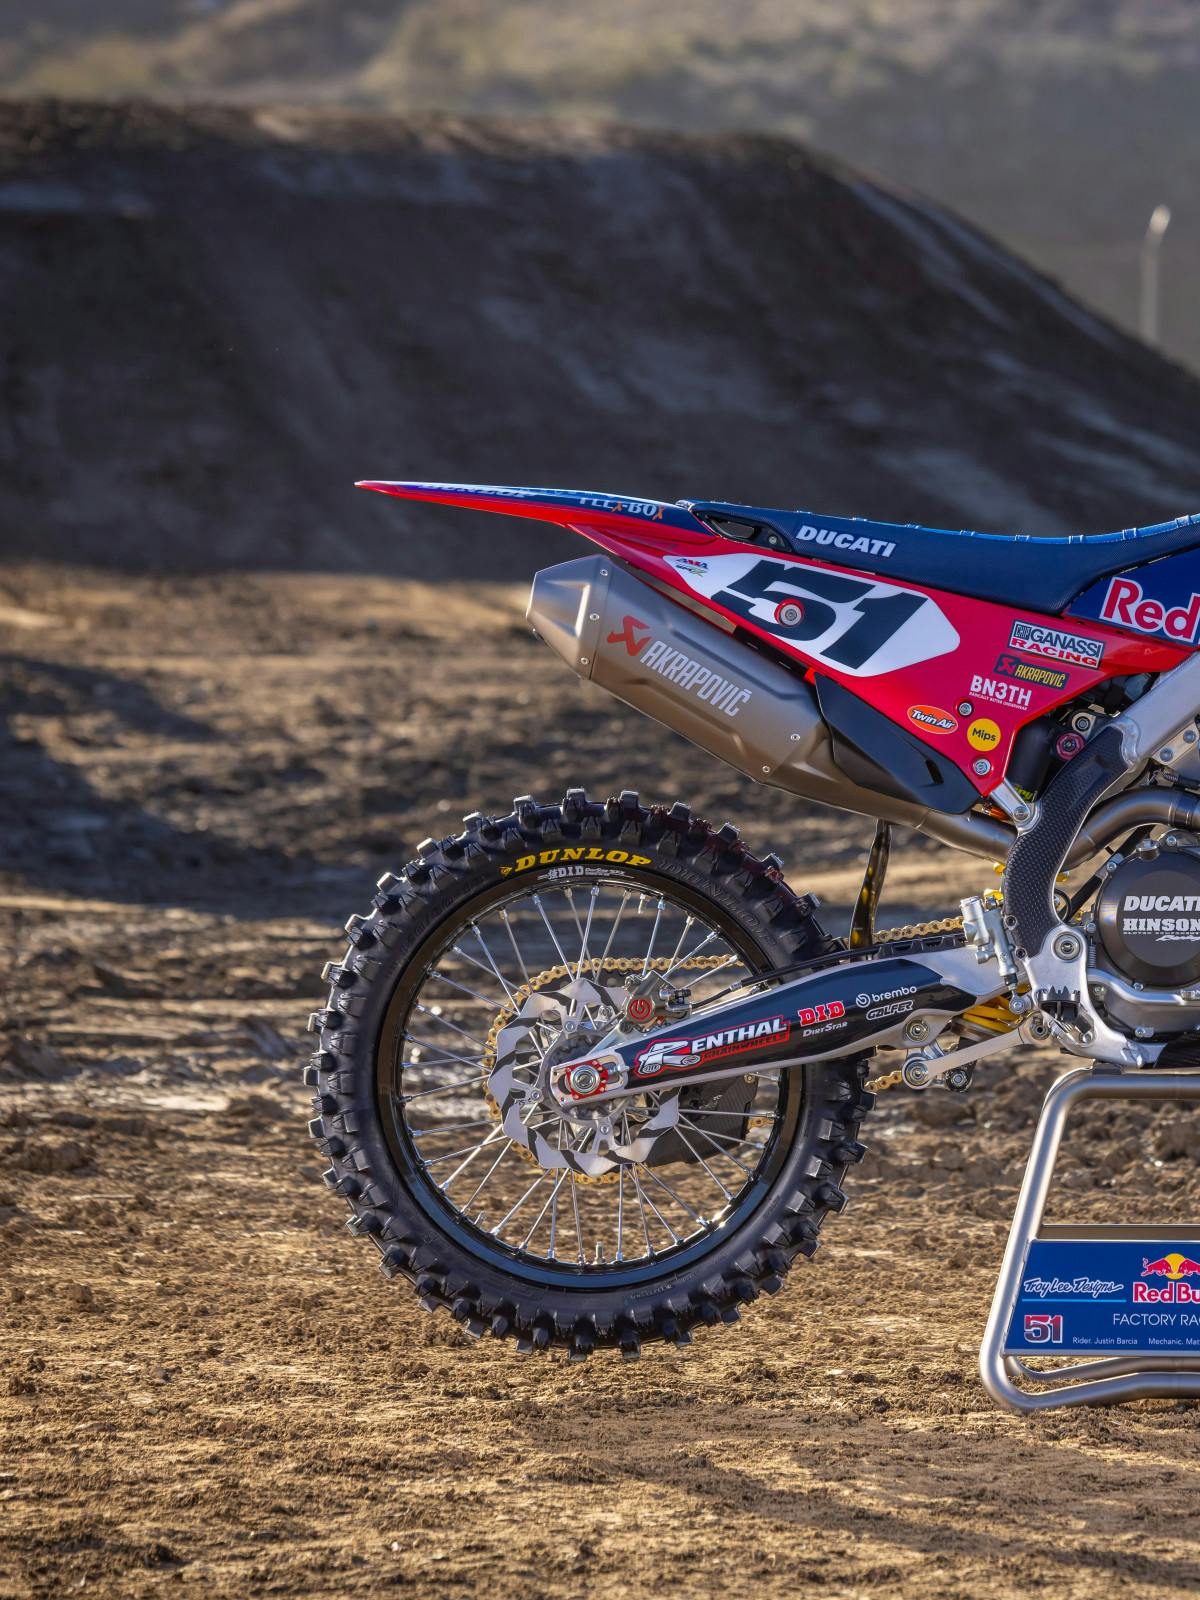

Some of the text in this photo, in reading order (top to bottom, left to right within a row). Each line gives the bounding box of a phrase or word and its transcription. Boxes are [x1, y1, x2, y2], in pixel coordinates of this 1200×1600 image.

[795, 525, 896, 558] DUCATI
[710, 560, 928, 669] 51
[1011, 638, 1097, 667] RACING
[1030, 628, 1103, 658] GANASSI
[640, 640, 752, 717] AKRAPOVIČ
[970, 675, 1032, 706] BN3TH
[911, 708, 955, 730] Twin Air
[972, 728, 996, 742] Mips
[515, 847, 653, 872] DUNLOP
[872, 985, 917, 1003] brembo
[798, 1001, 846, 1026] DID
[866, 999, 914, 1021] GALFER
[1023, 1277, 1124, 1299] Troy Lee Designs
[1133, 1281, 1175, 1304] Red
[1024, 1314, 1063, 1343] 51
[1113, 1313, 1177, 1326] FACTORY
[1094, 1337, 1115, 1345] Justin
[1116, 1337, 1138, 1345] Barcia
